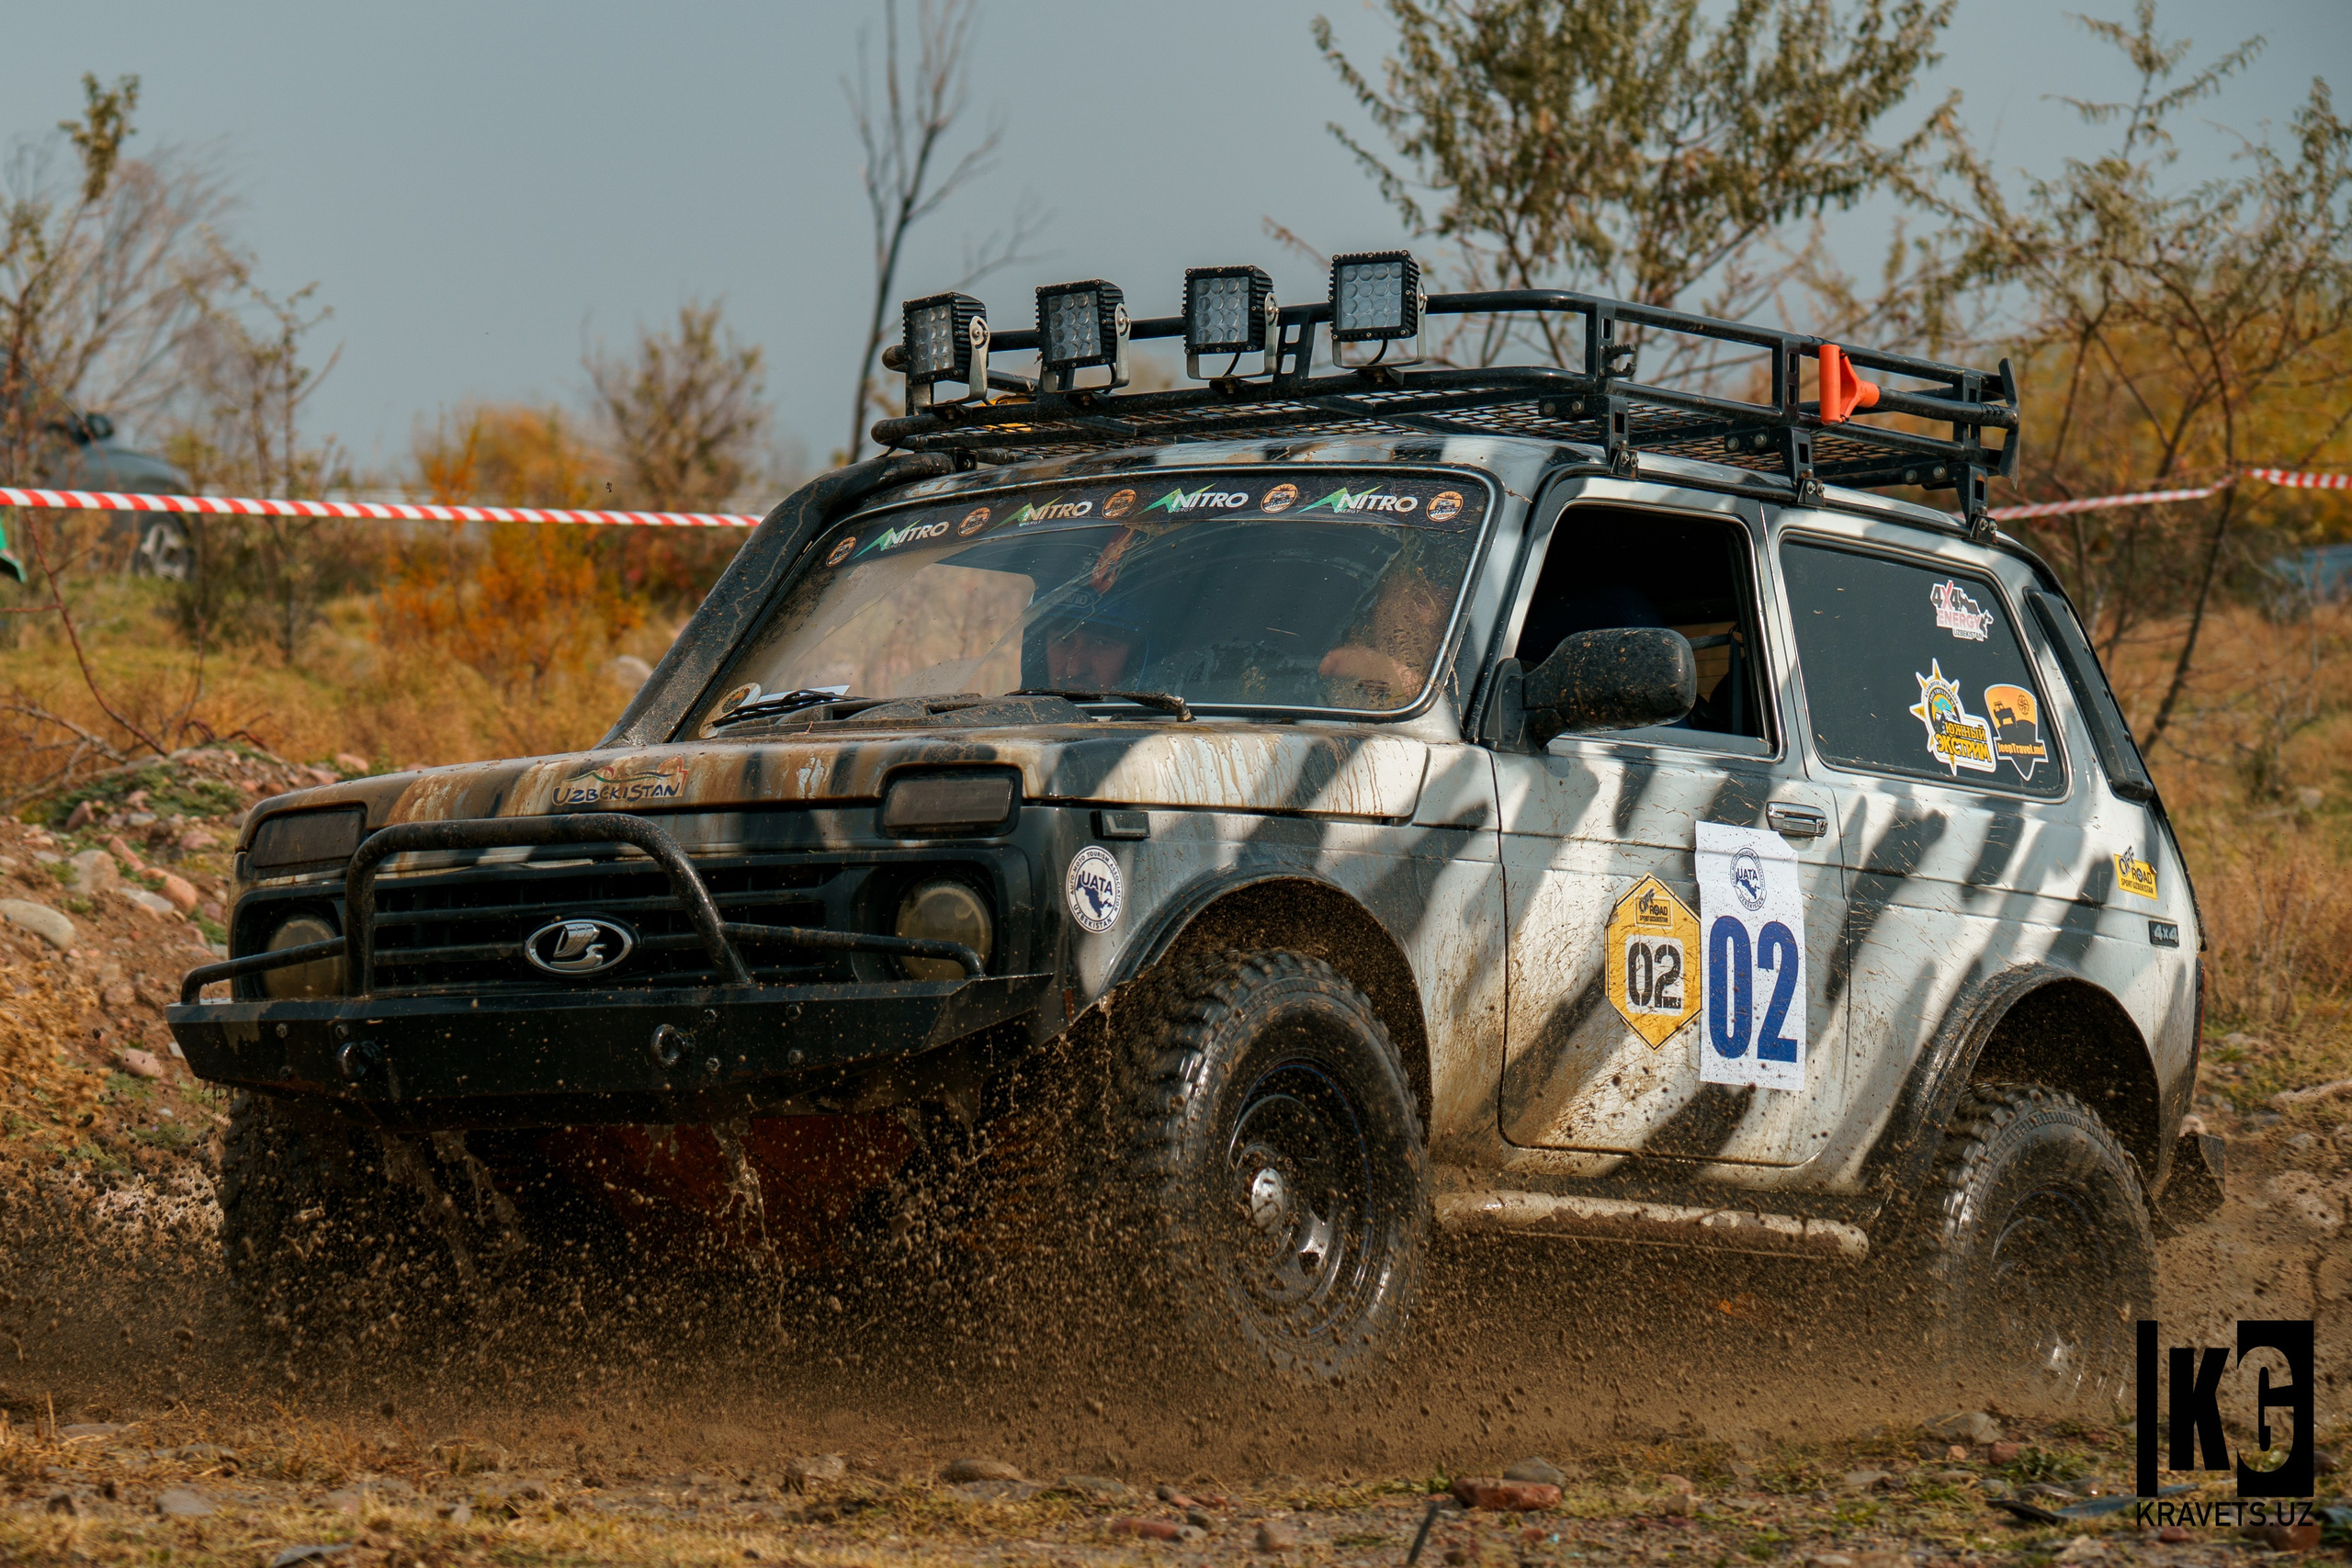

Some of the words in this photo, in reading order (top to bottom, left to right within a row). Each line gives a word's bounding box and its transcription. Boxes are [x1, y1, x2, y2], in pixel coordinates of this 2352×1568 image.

[1171, 491, 1249, 508] NITRO
[1336, 493, 1419, 513] NITRO
[1021, 501, 1092, 523] NITRO
[884, 521, 950, 547] NITRO
[1938, 610, 1982, 631] ENERGY
[1954, 628, 1984, 640] UZBEKISTAN
[1945, 724, 1986, 741] ЮЖНЫЙ
[1935, 733, 1992, 762] ЭКСТРИМ
[553, 783, 680, 805] UZBEKISTAN
[2119, 845, 2134, 876] OFF
[1081, 870, 1114, 897] UATA
[1086, 851, 1110, 863] TOURISM
[1109, 863, 1121, 913] ASSOCIATION
[1736, 867, 1758, 881] UATA
[2120, 877, 2132, 887] SPORT
[2132, 866, 2153, 885] ROAD
[1639, 887, 1656, 913] OFF
[1649, 905, 1668, 916] ROAD
[1073, 904, 1113, 930] UZBEKISTAN
[1627, 942, 1682, 1010] 02
[1708, 915, 1799, 1064] 02
